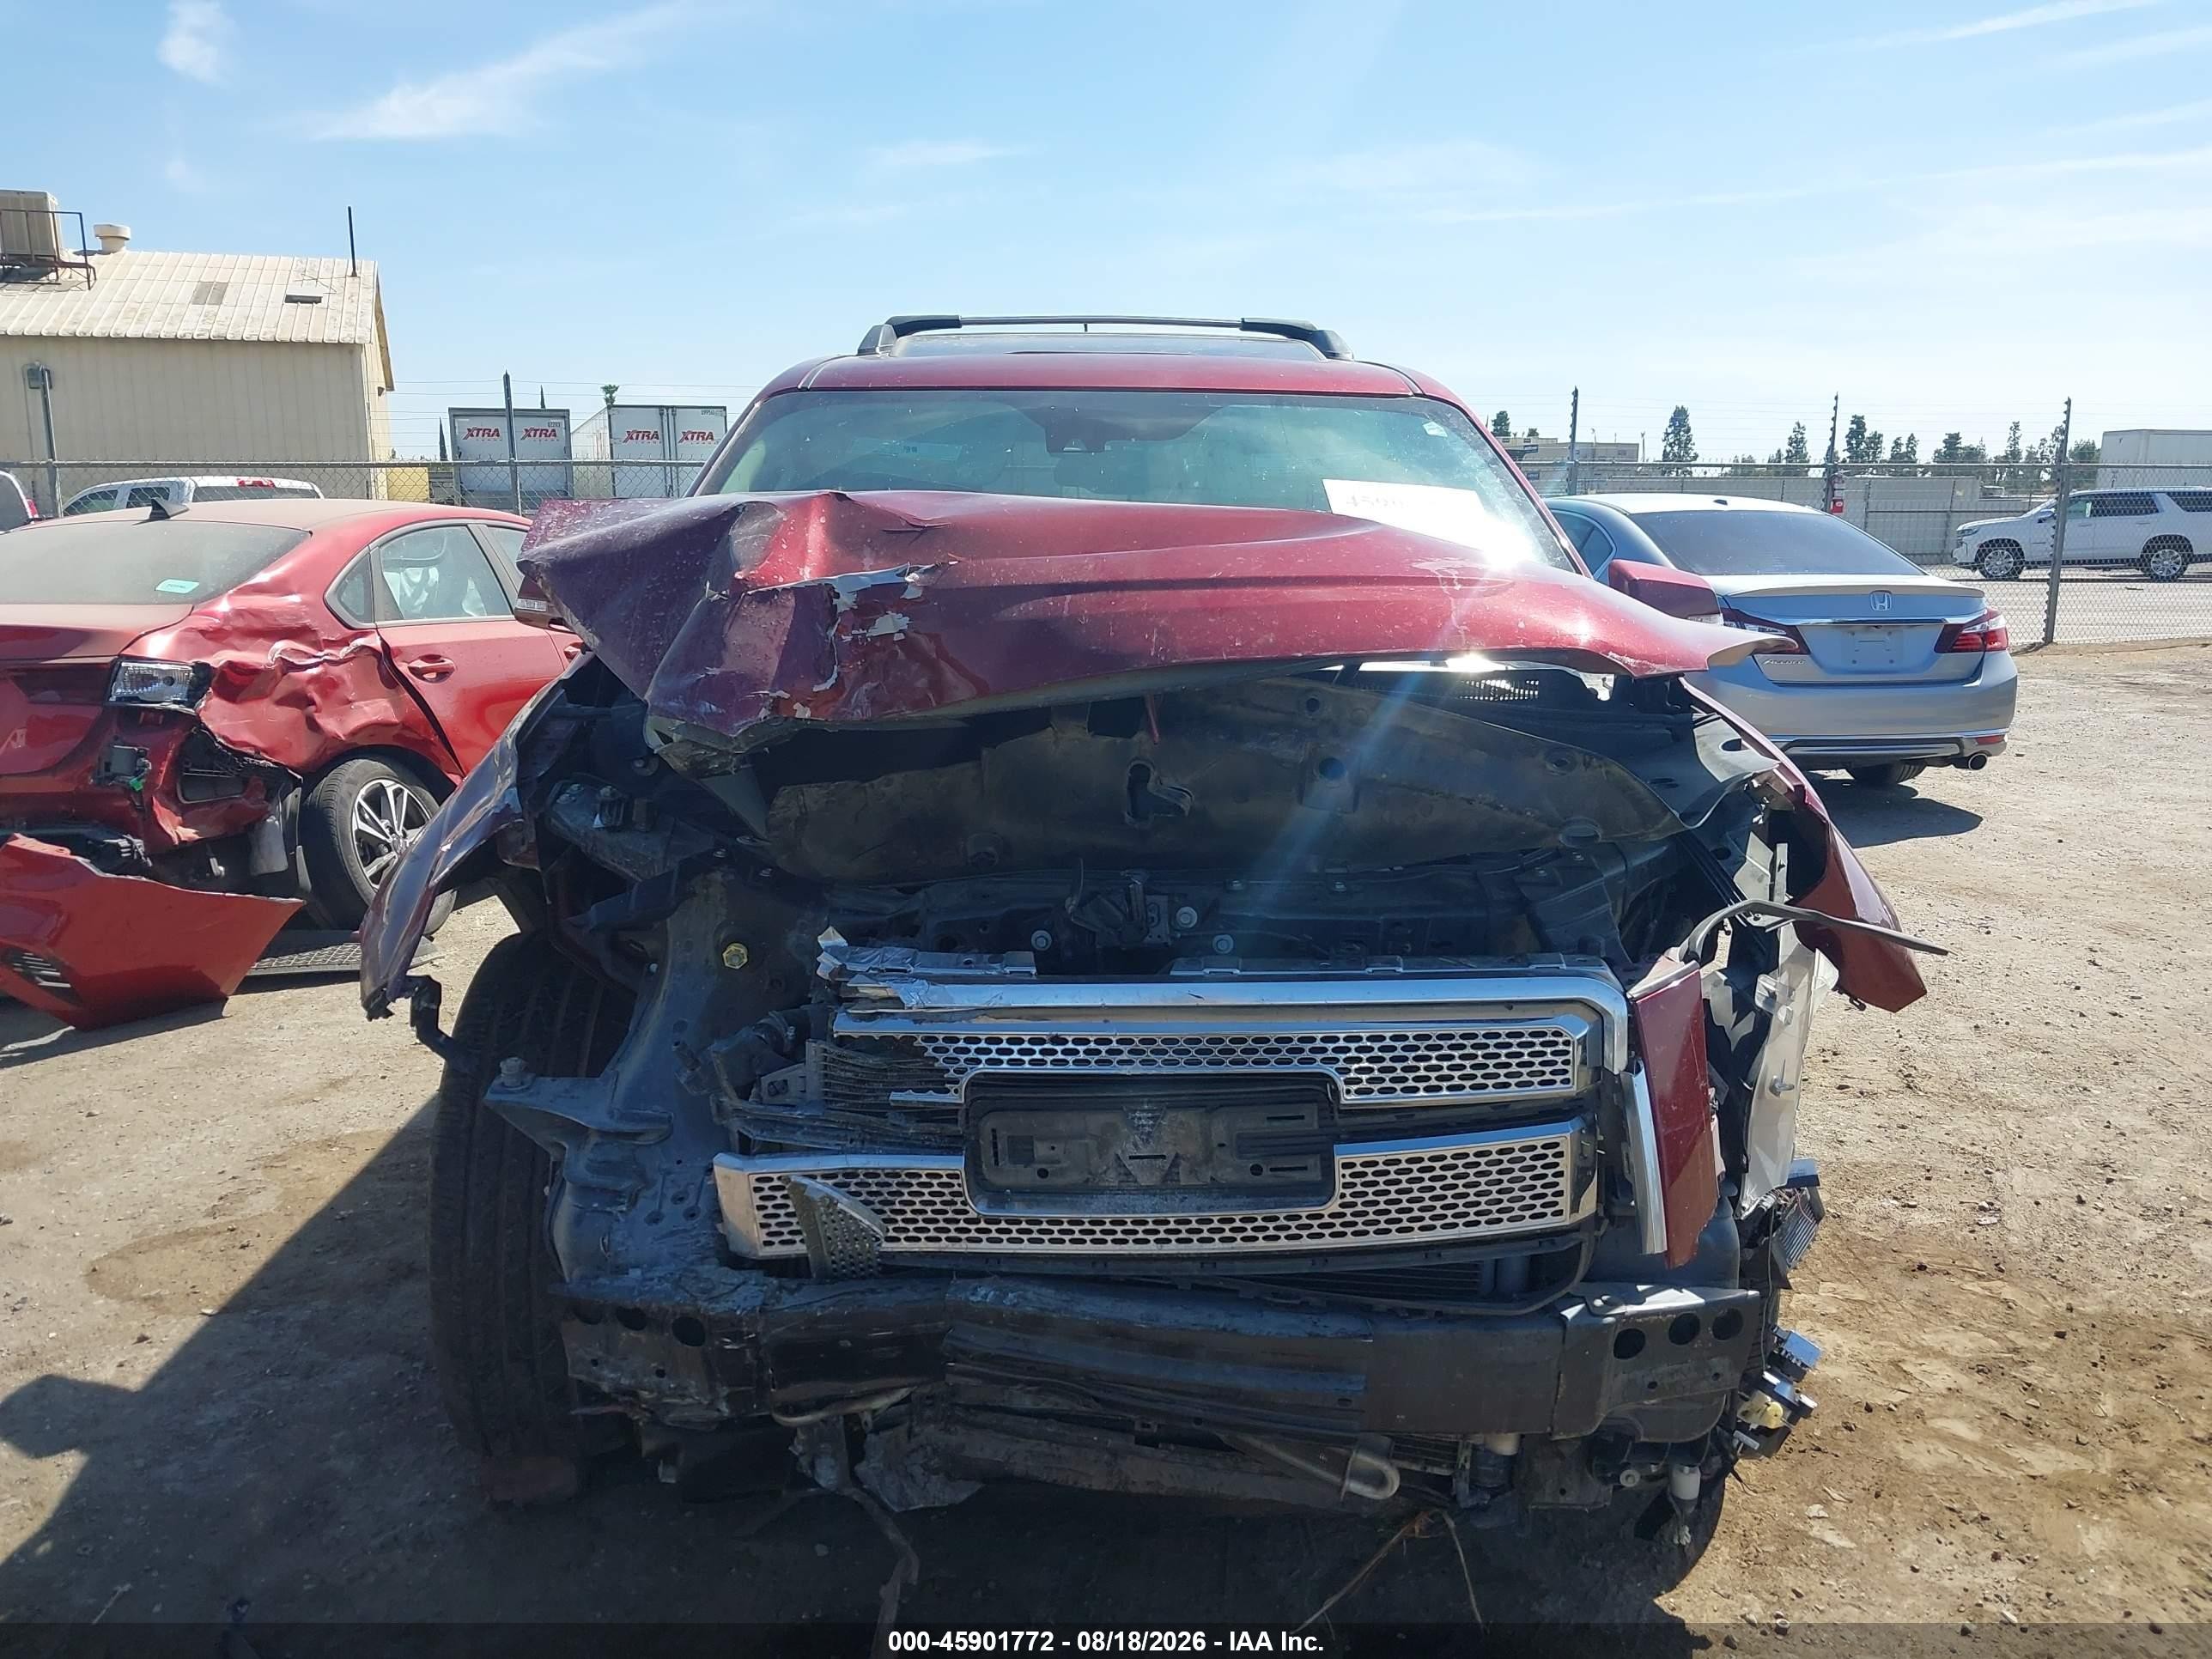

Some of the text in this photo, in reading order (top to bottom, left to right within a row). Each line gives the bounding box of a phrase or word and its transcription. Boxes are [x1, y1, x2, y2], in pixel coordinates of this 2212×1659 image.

[462, 427, 501, 441] XTRA
[520, 428, 558, 441] XTRA
[623, 429, 660, 443] XTRA
[678, 430, 714, 444] XTRA
